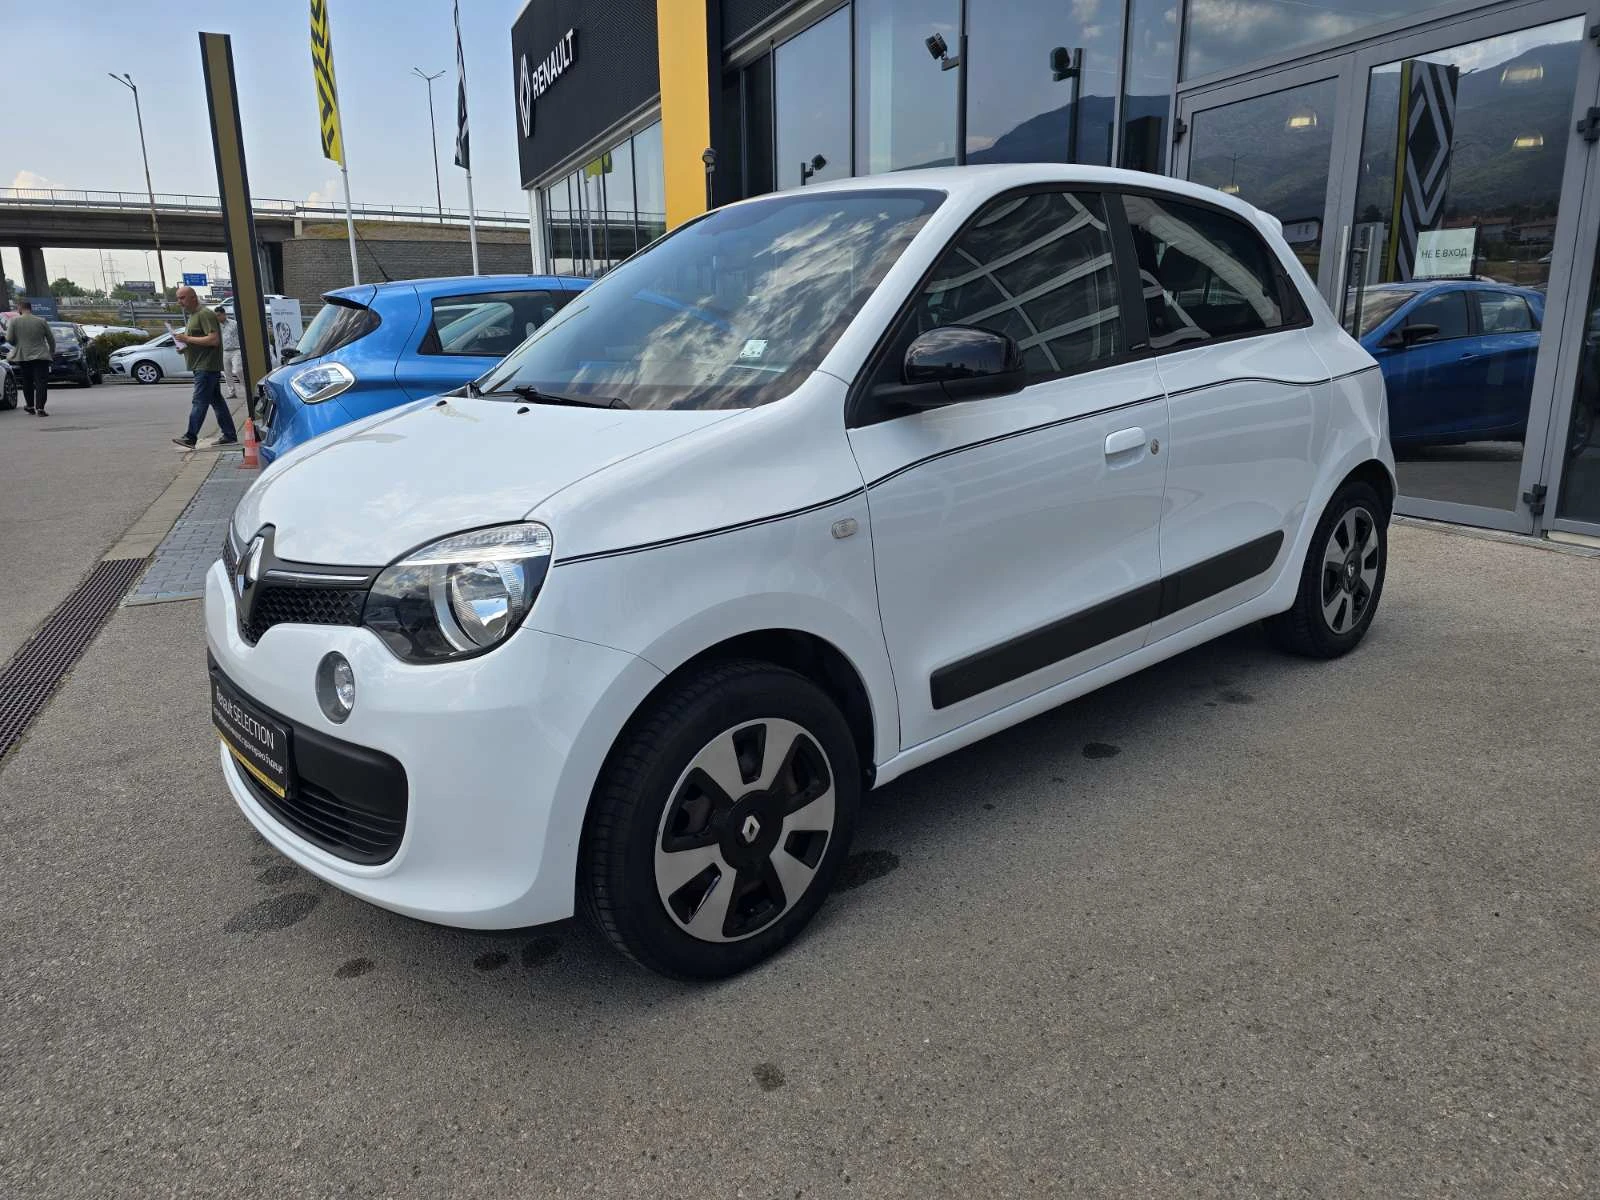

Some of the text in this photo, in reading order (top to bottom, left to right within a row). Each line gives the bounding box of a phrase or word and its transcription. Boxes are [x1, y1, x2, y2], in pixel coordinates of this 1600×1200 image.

[532, 28, 574, 100] RENAULT
[1421, 247, 1467, 259] НЕ Е ВХОД
[233, 704, 274, 750] SELECTION
